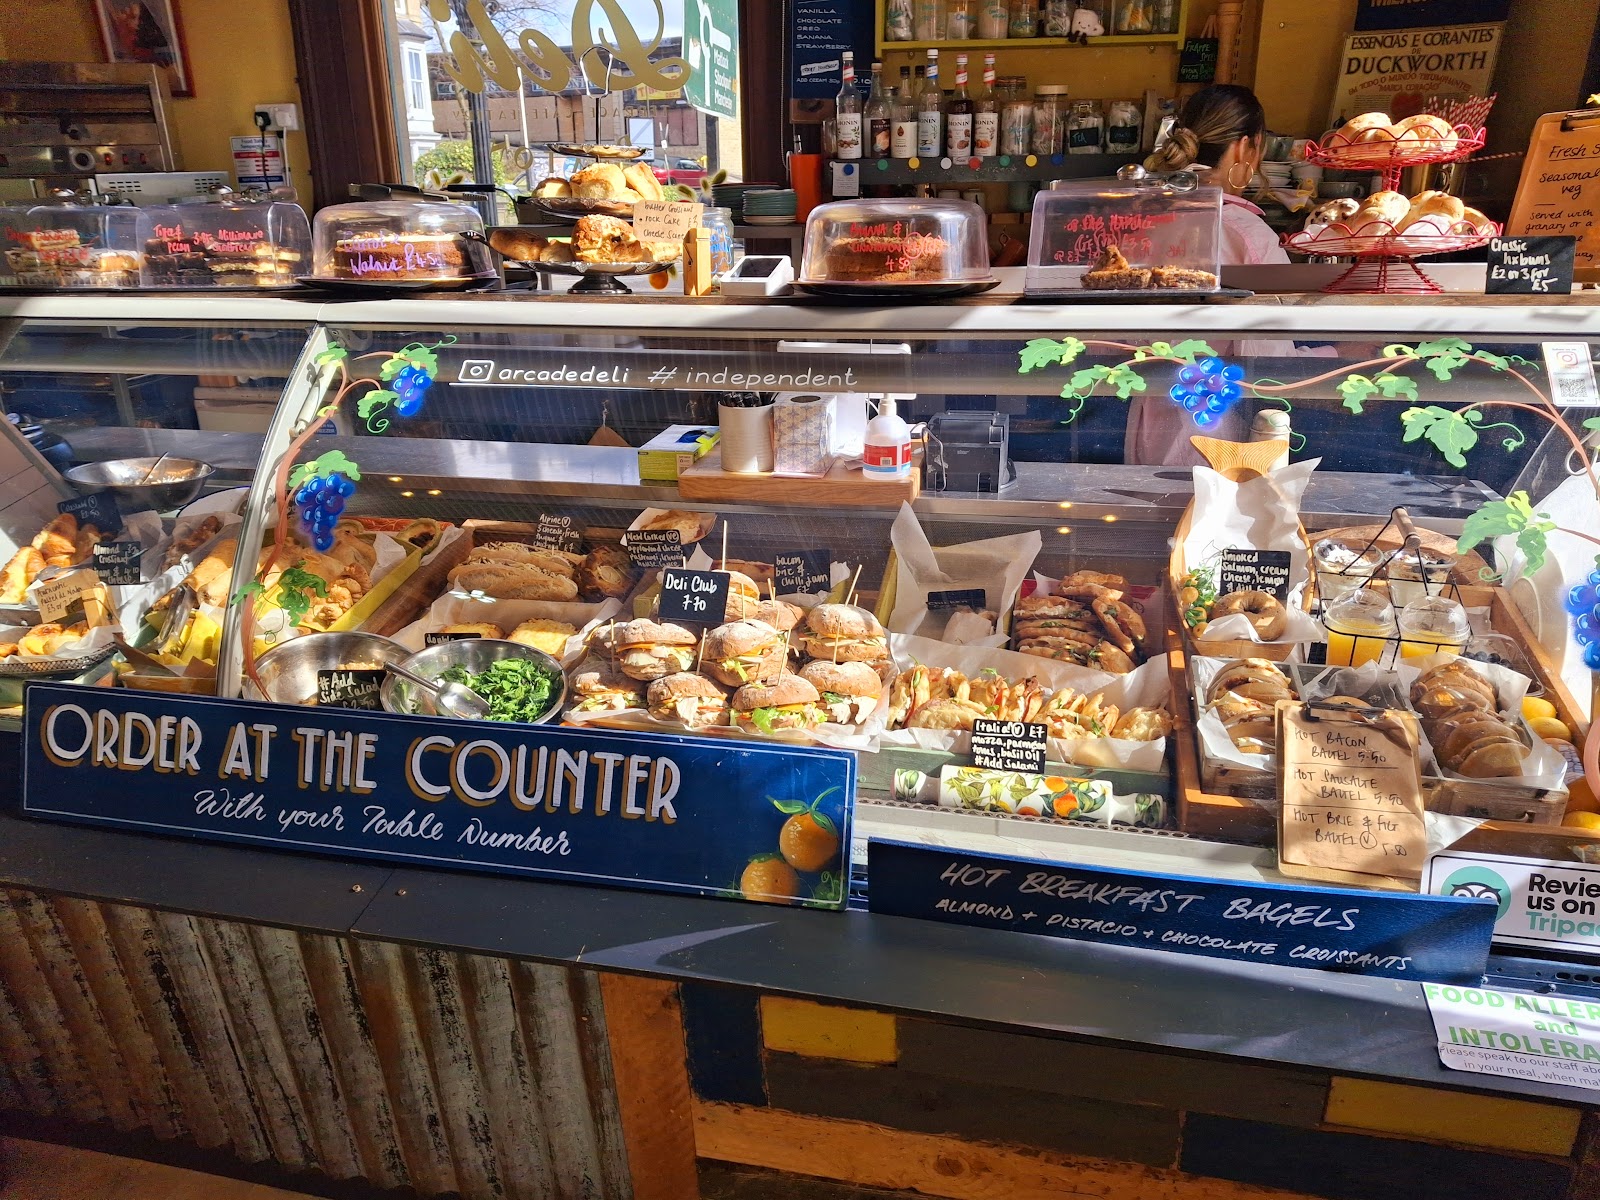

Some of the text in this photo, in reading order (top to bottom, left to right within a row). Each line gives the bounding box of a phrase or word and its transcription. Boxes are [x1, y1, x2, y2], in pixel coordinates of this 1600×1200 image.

[1351, 28, 1495, 50] ESSENCIAS E CORANTES
[1345, 51, 1488, 75] DUCKWORTH
[1359, 78, 1379, 90] TODO
[1380, 76, 1387, 84] O
[1388, 72, 1416, 82] MUNDO
[1548, 144, 1586, 158] Fresh
[1562, 184, 1582, 200] veg
[1530, 209, 1594, 220] served with
[1525, 222, 1566, 234] granary
[1490, 238, 1528, 253] Classic
[350, 252, 403, 276] Walnut
[1491, 266, 1506, 280] £2
[1520, 268, 1530, 279] 3
[1530, 268, 1550, 282] for
[1532, 278, 1558, 292] £5
[498, 364, 630, 384] arcadedeli
[686, 367, 858, 389] independent
[540, 514, 561, 524] Alpine
[93, 544, 120, 556] Almond
[1222, 550, 1258, 562] Smoked
[776, 566, 794, 576] brie
[806, 572, 828, 587] jam
[665, 573, 718, 594] Deli Club
[320, 676, 381, 704] Side Salad
[1294, 727, 1367, 746] HOT BACON
[43, 703, 682, 823] ORDER AT THE COUNTER
[1294, 769, 1316, 782] HOT
[194, 788, 572, 856] With your Table Number
[1294, 808, 1320, 824] HOT
[1326, 812, 1355, 826] BRIE
[940, 862, 1360, 932] HOT BREAKFAST BAGELS
[1527, 895, 1596, 916] us on
[935, 898, 1014, 920] ALMOND
[1161, 930, 1278, 956] CHOCOLATE
[1288, 944, 1412, 971] CROISSANTS
[1425, 984, 1505, 1008] FOOD
[1533, 1020, 1580, 1036] and
[1439, 1045, 1476, 1058] Please
[1478, 1050, 1512, 1062] speak
[1514, 1055, 1526, 1064] to
[1529, 1058, 1550, 1068] our
[1552, 1060, 1579, 1072] staff
[1464, 1060, 1576, 1084] in your meal, when
